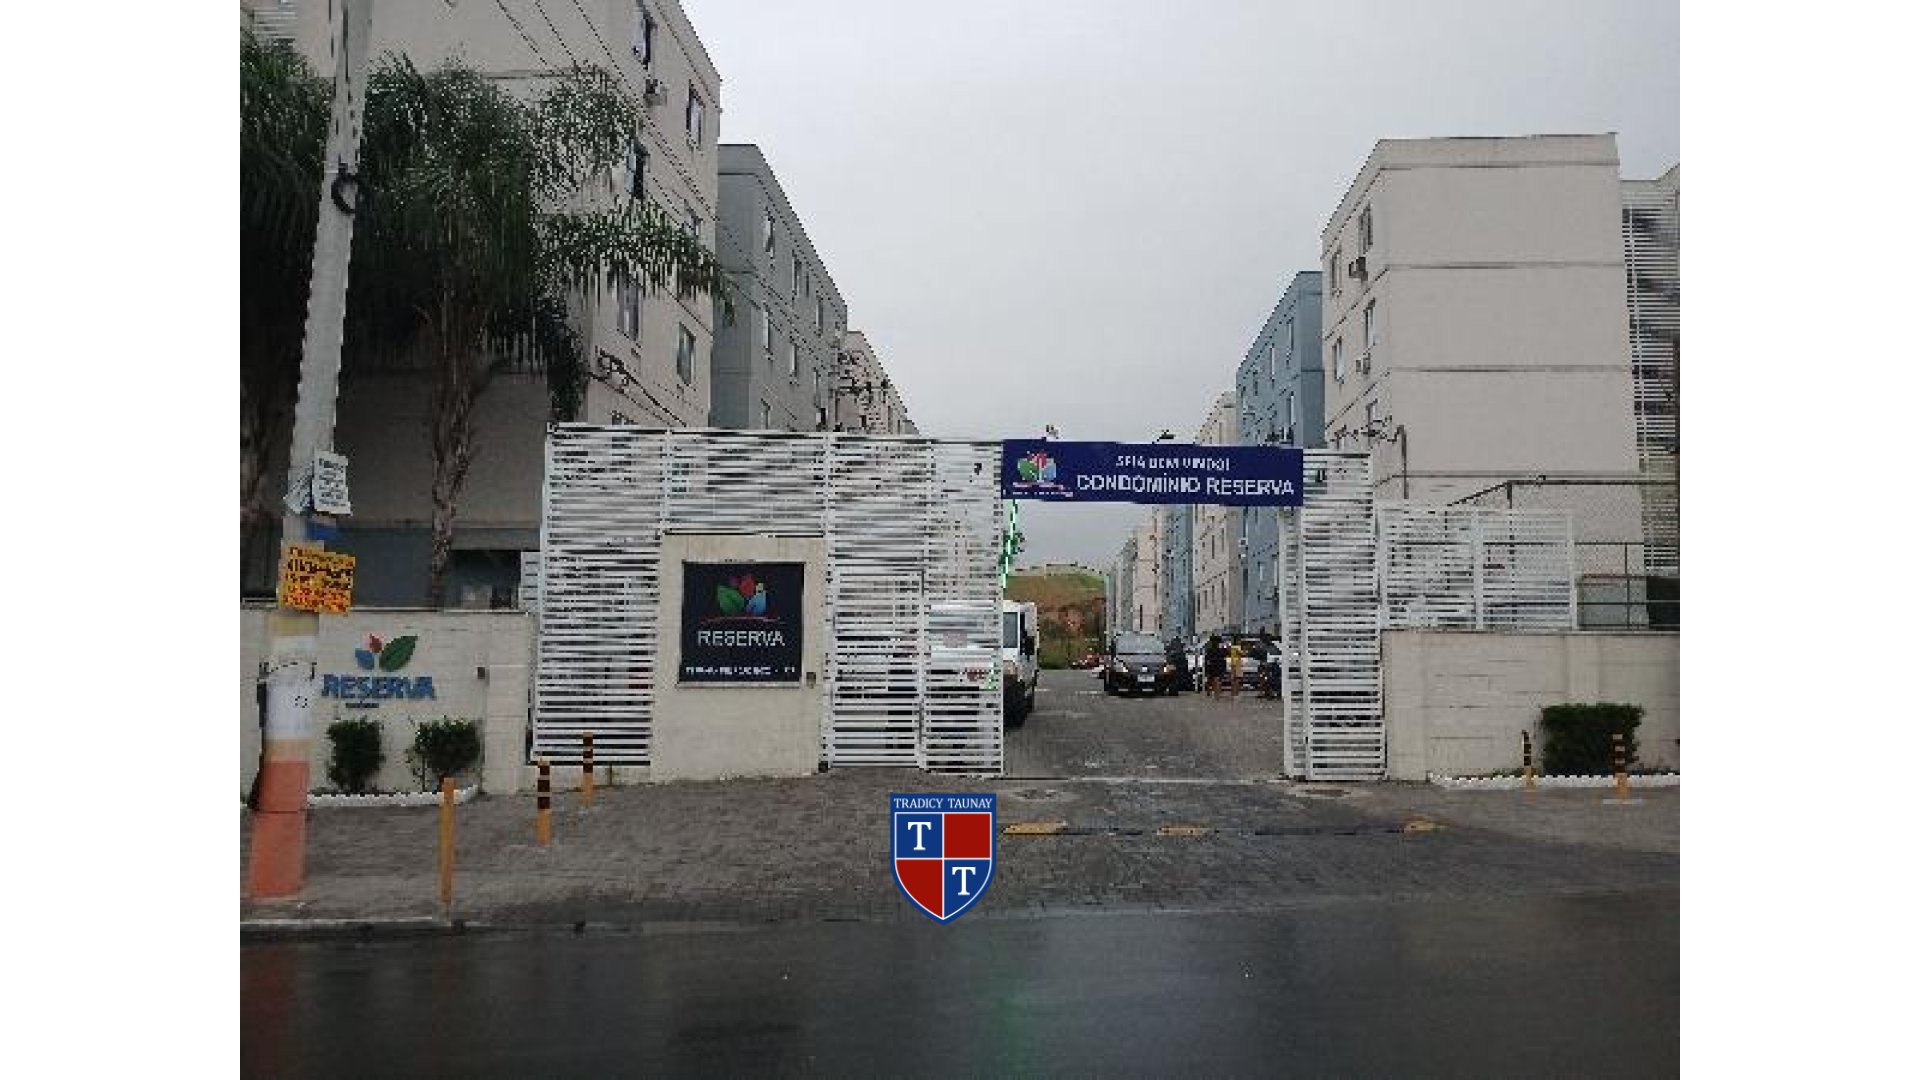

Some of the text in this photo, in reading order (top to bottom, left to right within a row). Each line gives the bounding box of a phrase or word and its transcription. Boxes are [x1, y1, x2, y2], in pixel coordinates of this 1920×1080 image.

[1206, 477, 1294, 496] RESERVA
[697, 630, 786, 647] RESERVA
[322, 674, 437, 700] RESERVA
